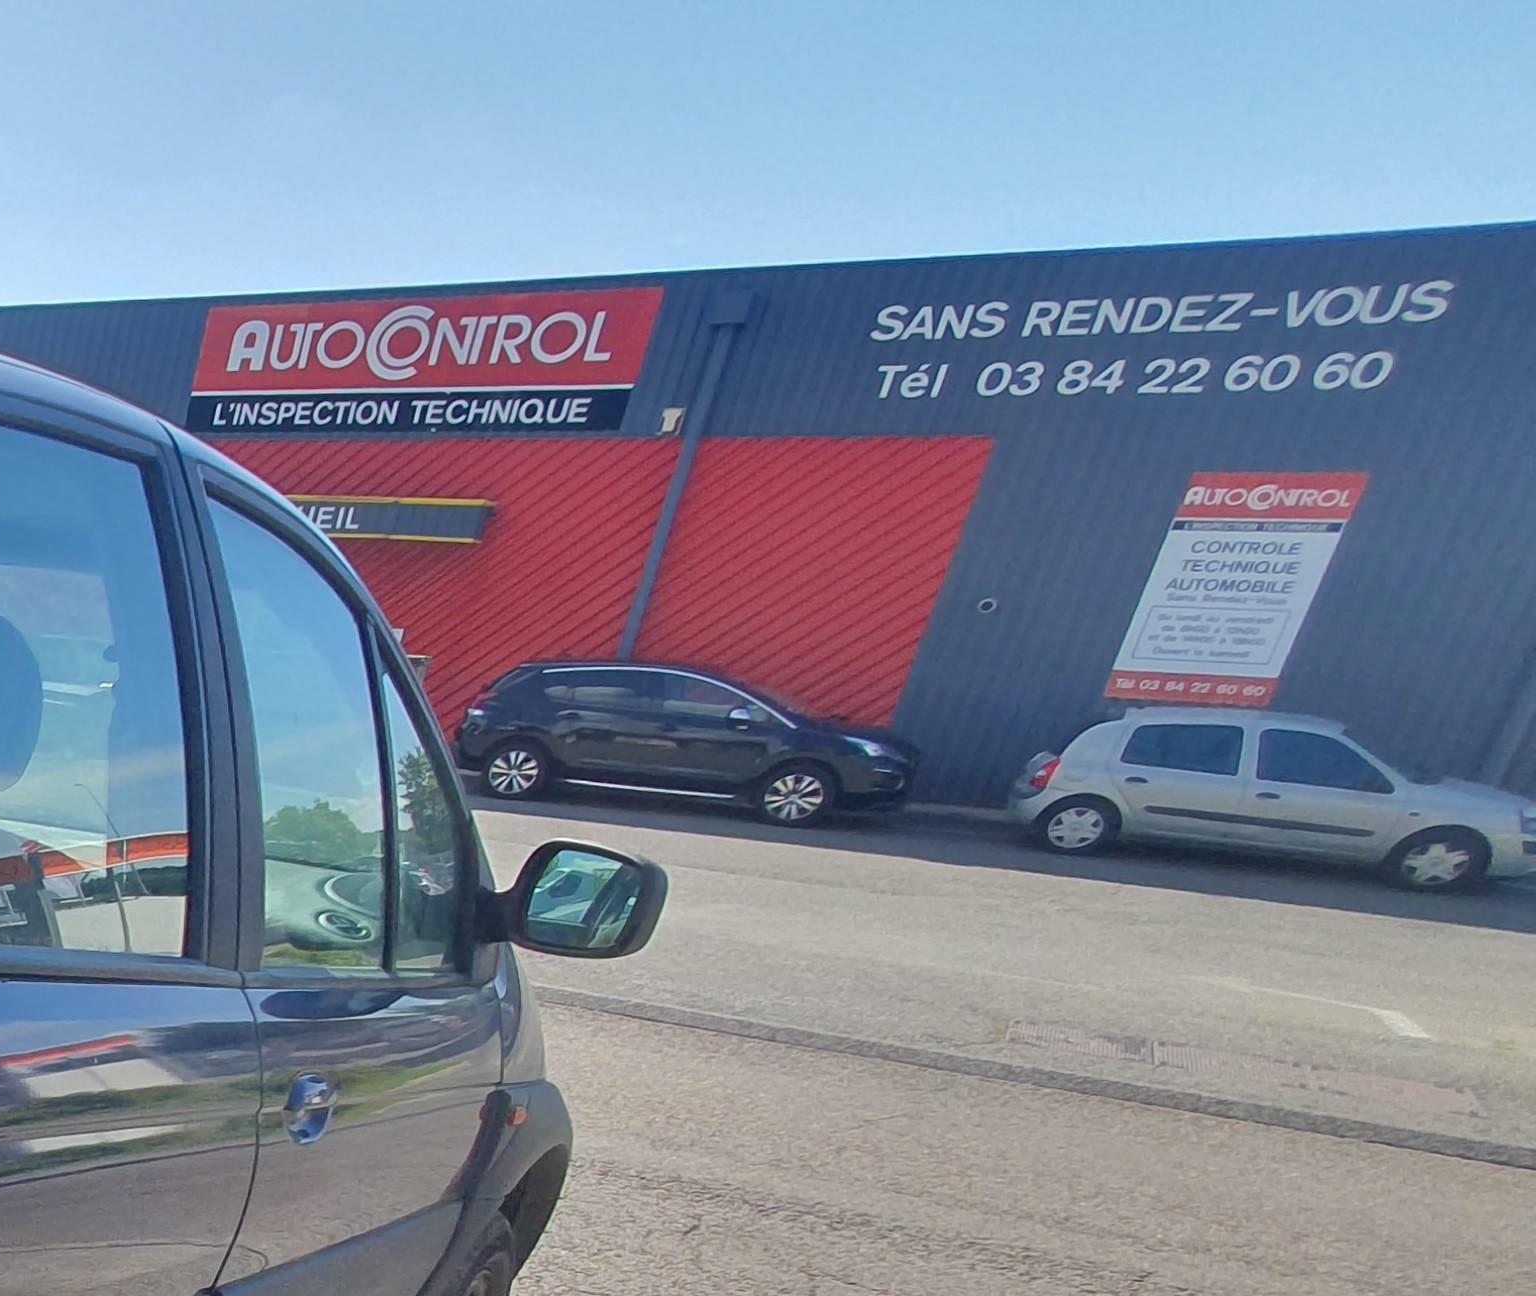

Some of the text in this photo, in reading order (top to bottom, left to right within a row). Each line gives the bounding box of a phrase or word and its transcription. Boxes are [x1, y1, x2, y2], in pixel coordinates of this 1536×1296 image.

[870, 279, 1455, 341] SANS RENDEZ-VOUS
[226, 305, 613, 381] AUTOCONTROL
[876, 350, 1395, 399] Tél 03 84 22 60 60
[212, 398, 593, 427] L'INSPECTION TECHNIQUE
[1183, 484, 1352, 511] AUTOCONTROL
[1181, 559, 1302, 576] TECHNIQUE
[1164, 578, 1297, 595] AUTOMOBILE
[1139, 679, 1161, 691] 03
[1164, 680, 1185, 693] 84
[1189, 682, 1212, 694] 22
[1216, 684, 1239, 696] 60
[1242, 685, 1266, 697] 60
